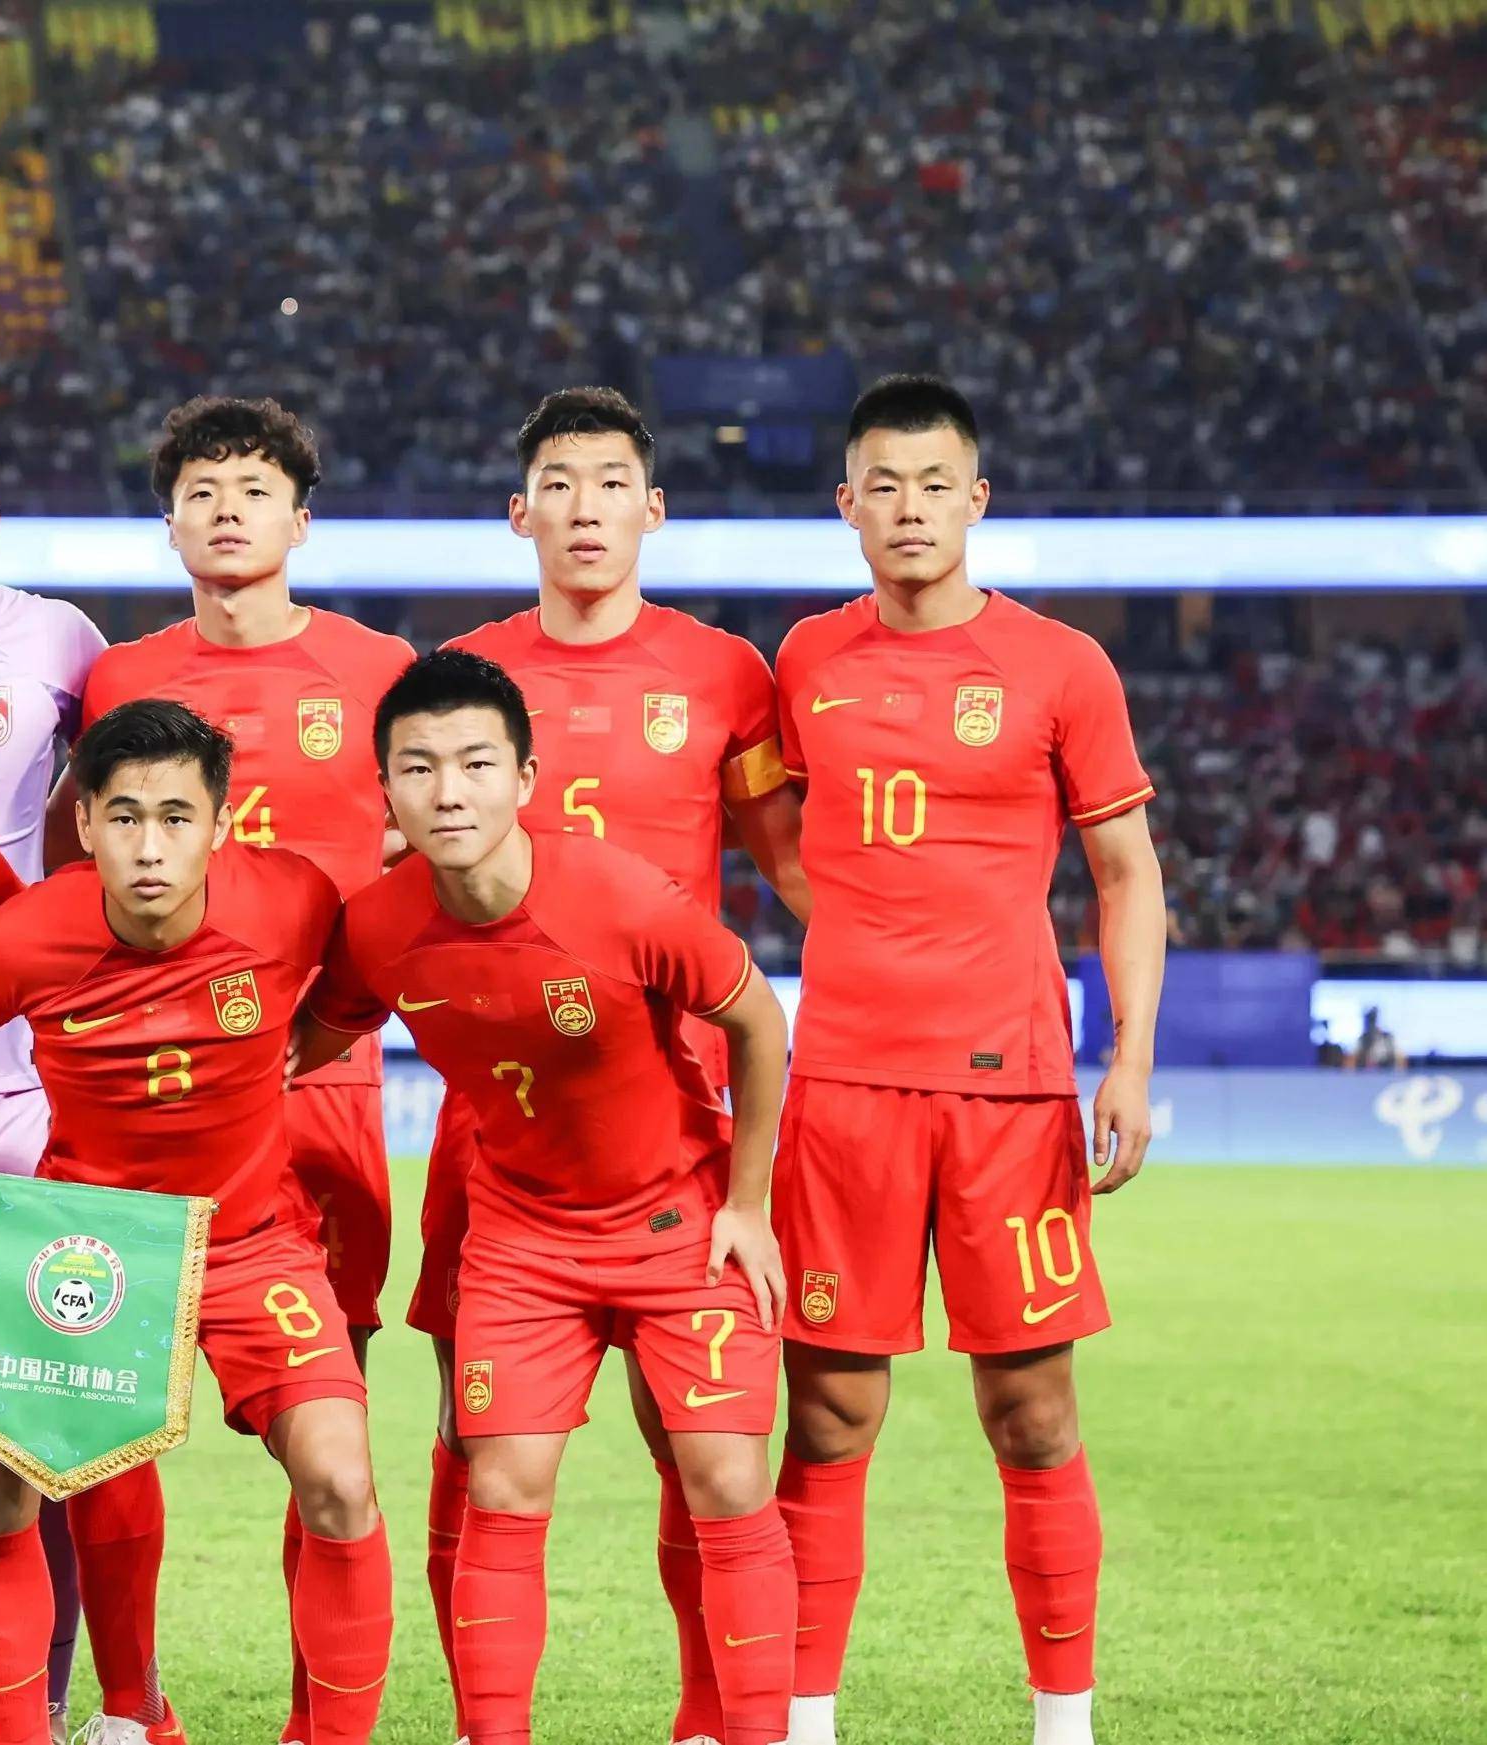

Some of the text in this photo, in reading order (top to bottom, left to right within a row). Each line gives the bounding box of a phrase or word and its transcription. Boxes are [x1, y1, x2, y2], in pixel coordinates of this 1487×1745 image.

[648, 697, 683, 710] CFA
[961, 690, 997, 703] CFA
[303, 703, 337, 715] CFA
[233, 785, 276, 849] 4
[562, 778, 604, 840] 5
[856, 768, 926, 846] 10
[215, 975, 251, 994] CFA
[547, 982, 584, 996] CFA
[147, 1045, 193, 1101] 8
[491, 1061, 535, 1118] 7
[1005, 1207, 1082, 1294] 10
[806, 1273, 834, 1287] CFA
[61, 1294, 87, 1308] CFA
[263, 1281, 322, 1339] 8
[691, 1309, 735, 1380] 7
[465, 1364, 489, 1375] CFA
[33, 1384, 77, 1399] FOOTBALL
[80, 1391, 137, 1405] ASSOCIATION
